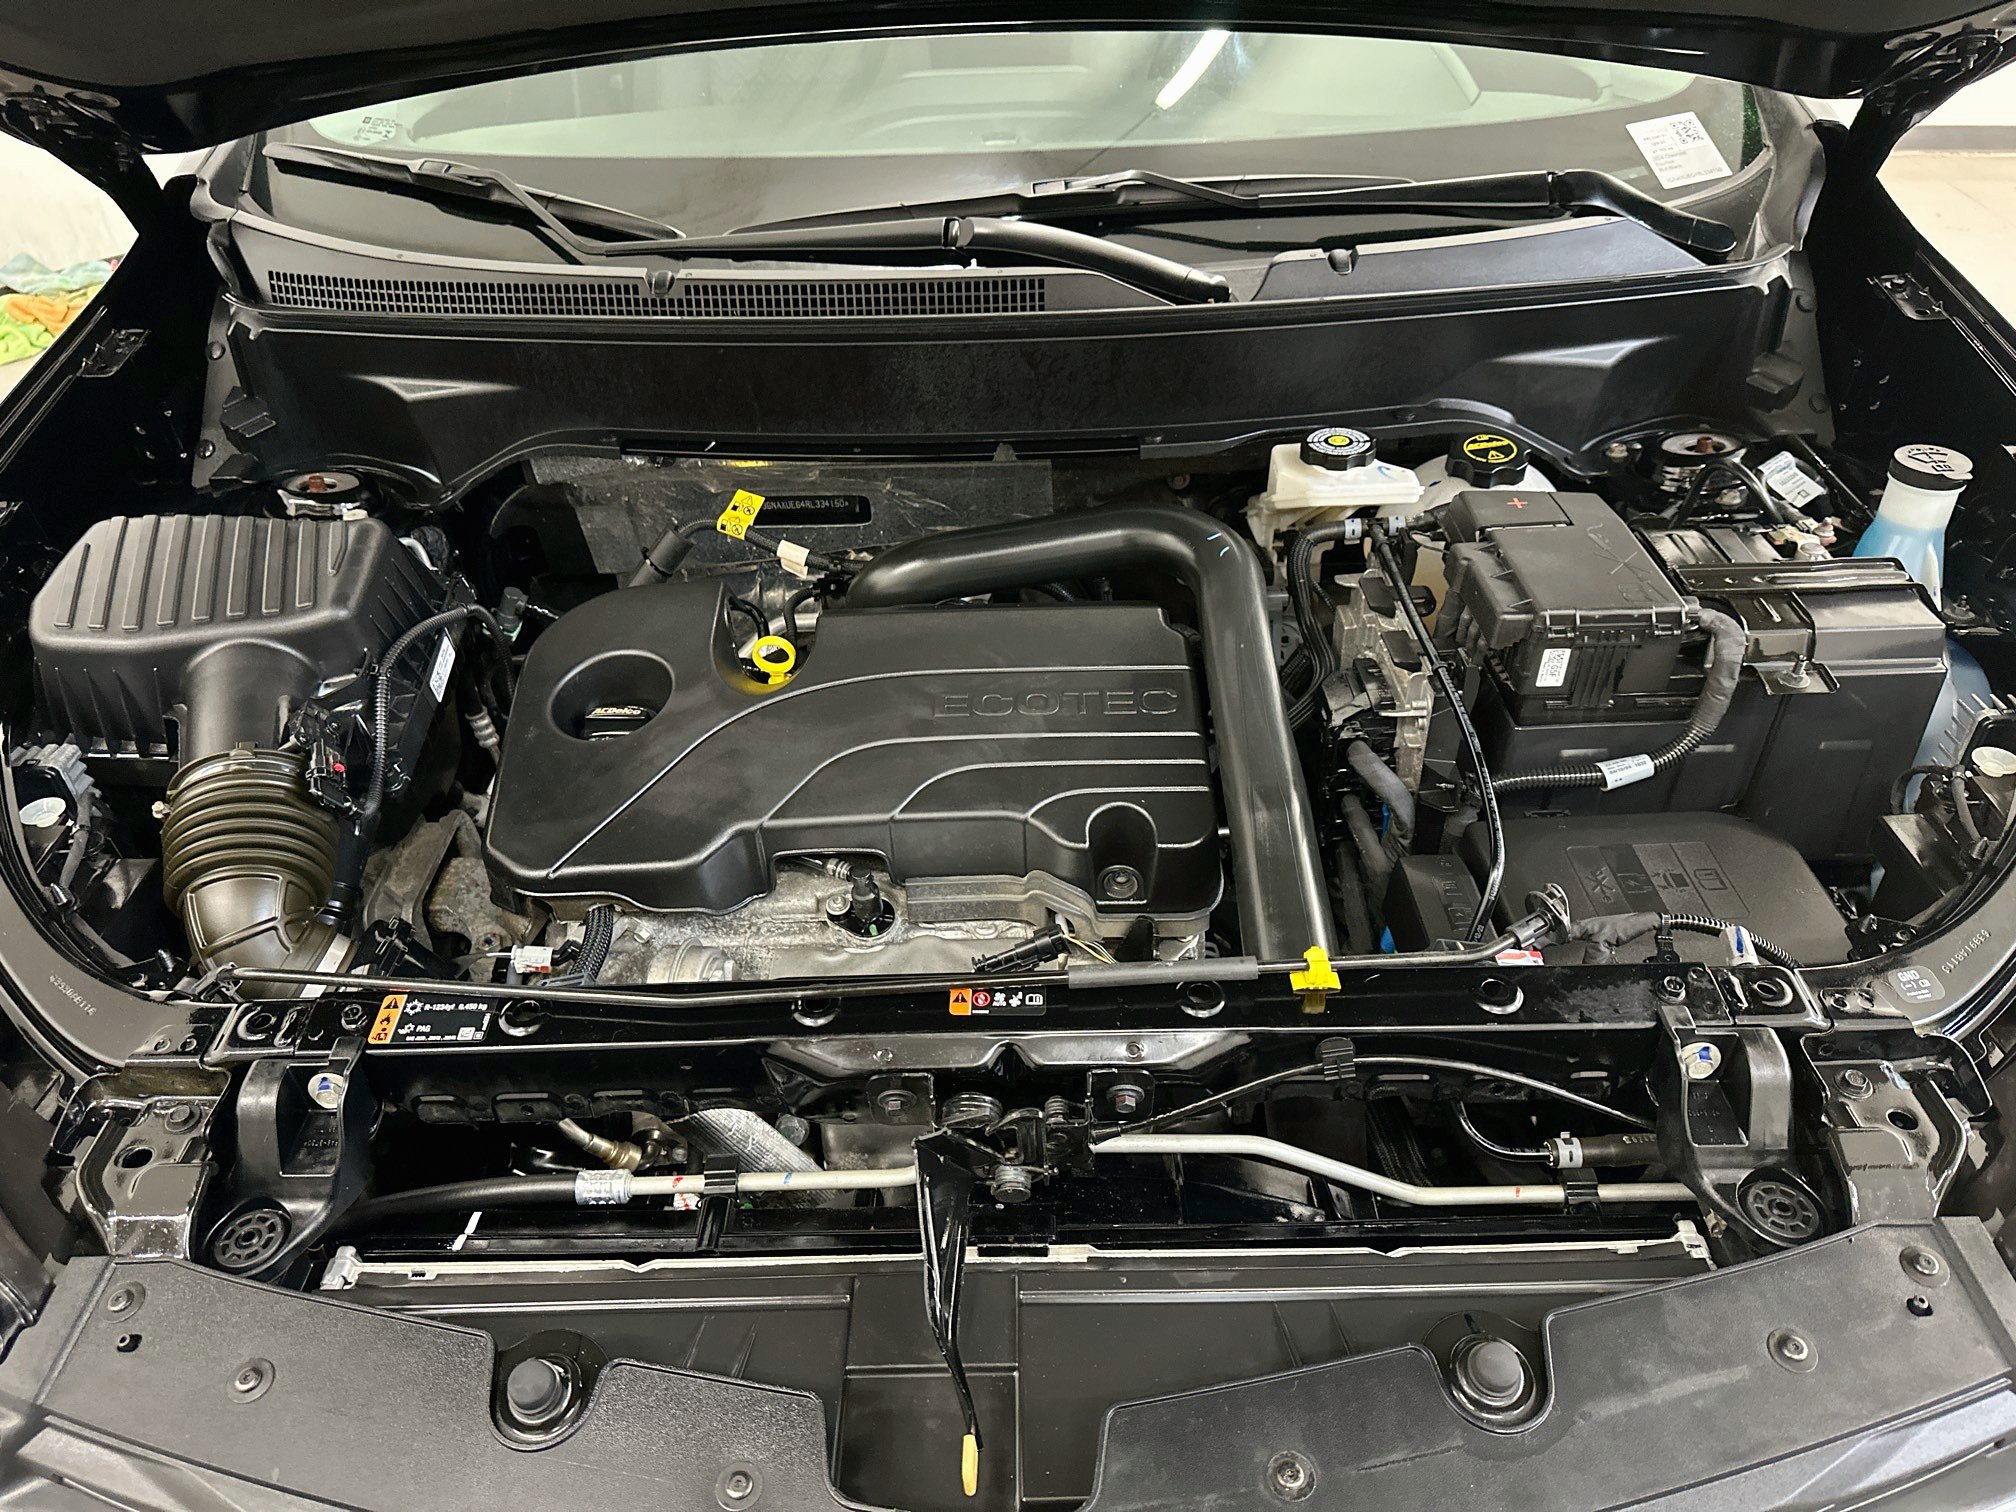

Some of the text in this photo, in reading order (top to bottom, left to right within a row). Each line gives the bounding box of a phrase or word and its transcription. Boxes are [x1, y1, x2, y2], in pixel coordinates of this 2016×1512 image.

[934, 689, 1178, 718] ECOTEC
[591, 707, 642, 716] ACDelco
[1897, 969, 1920, 982] GND
[416, 1024, 432, 1032] PAG
